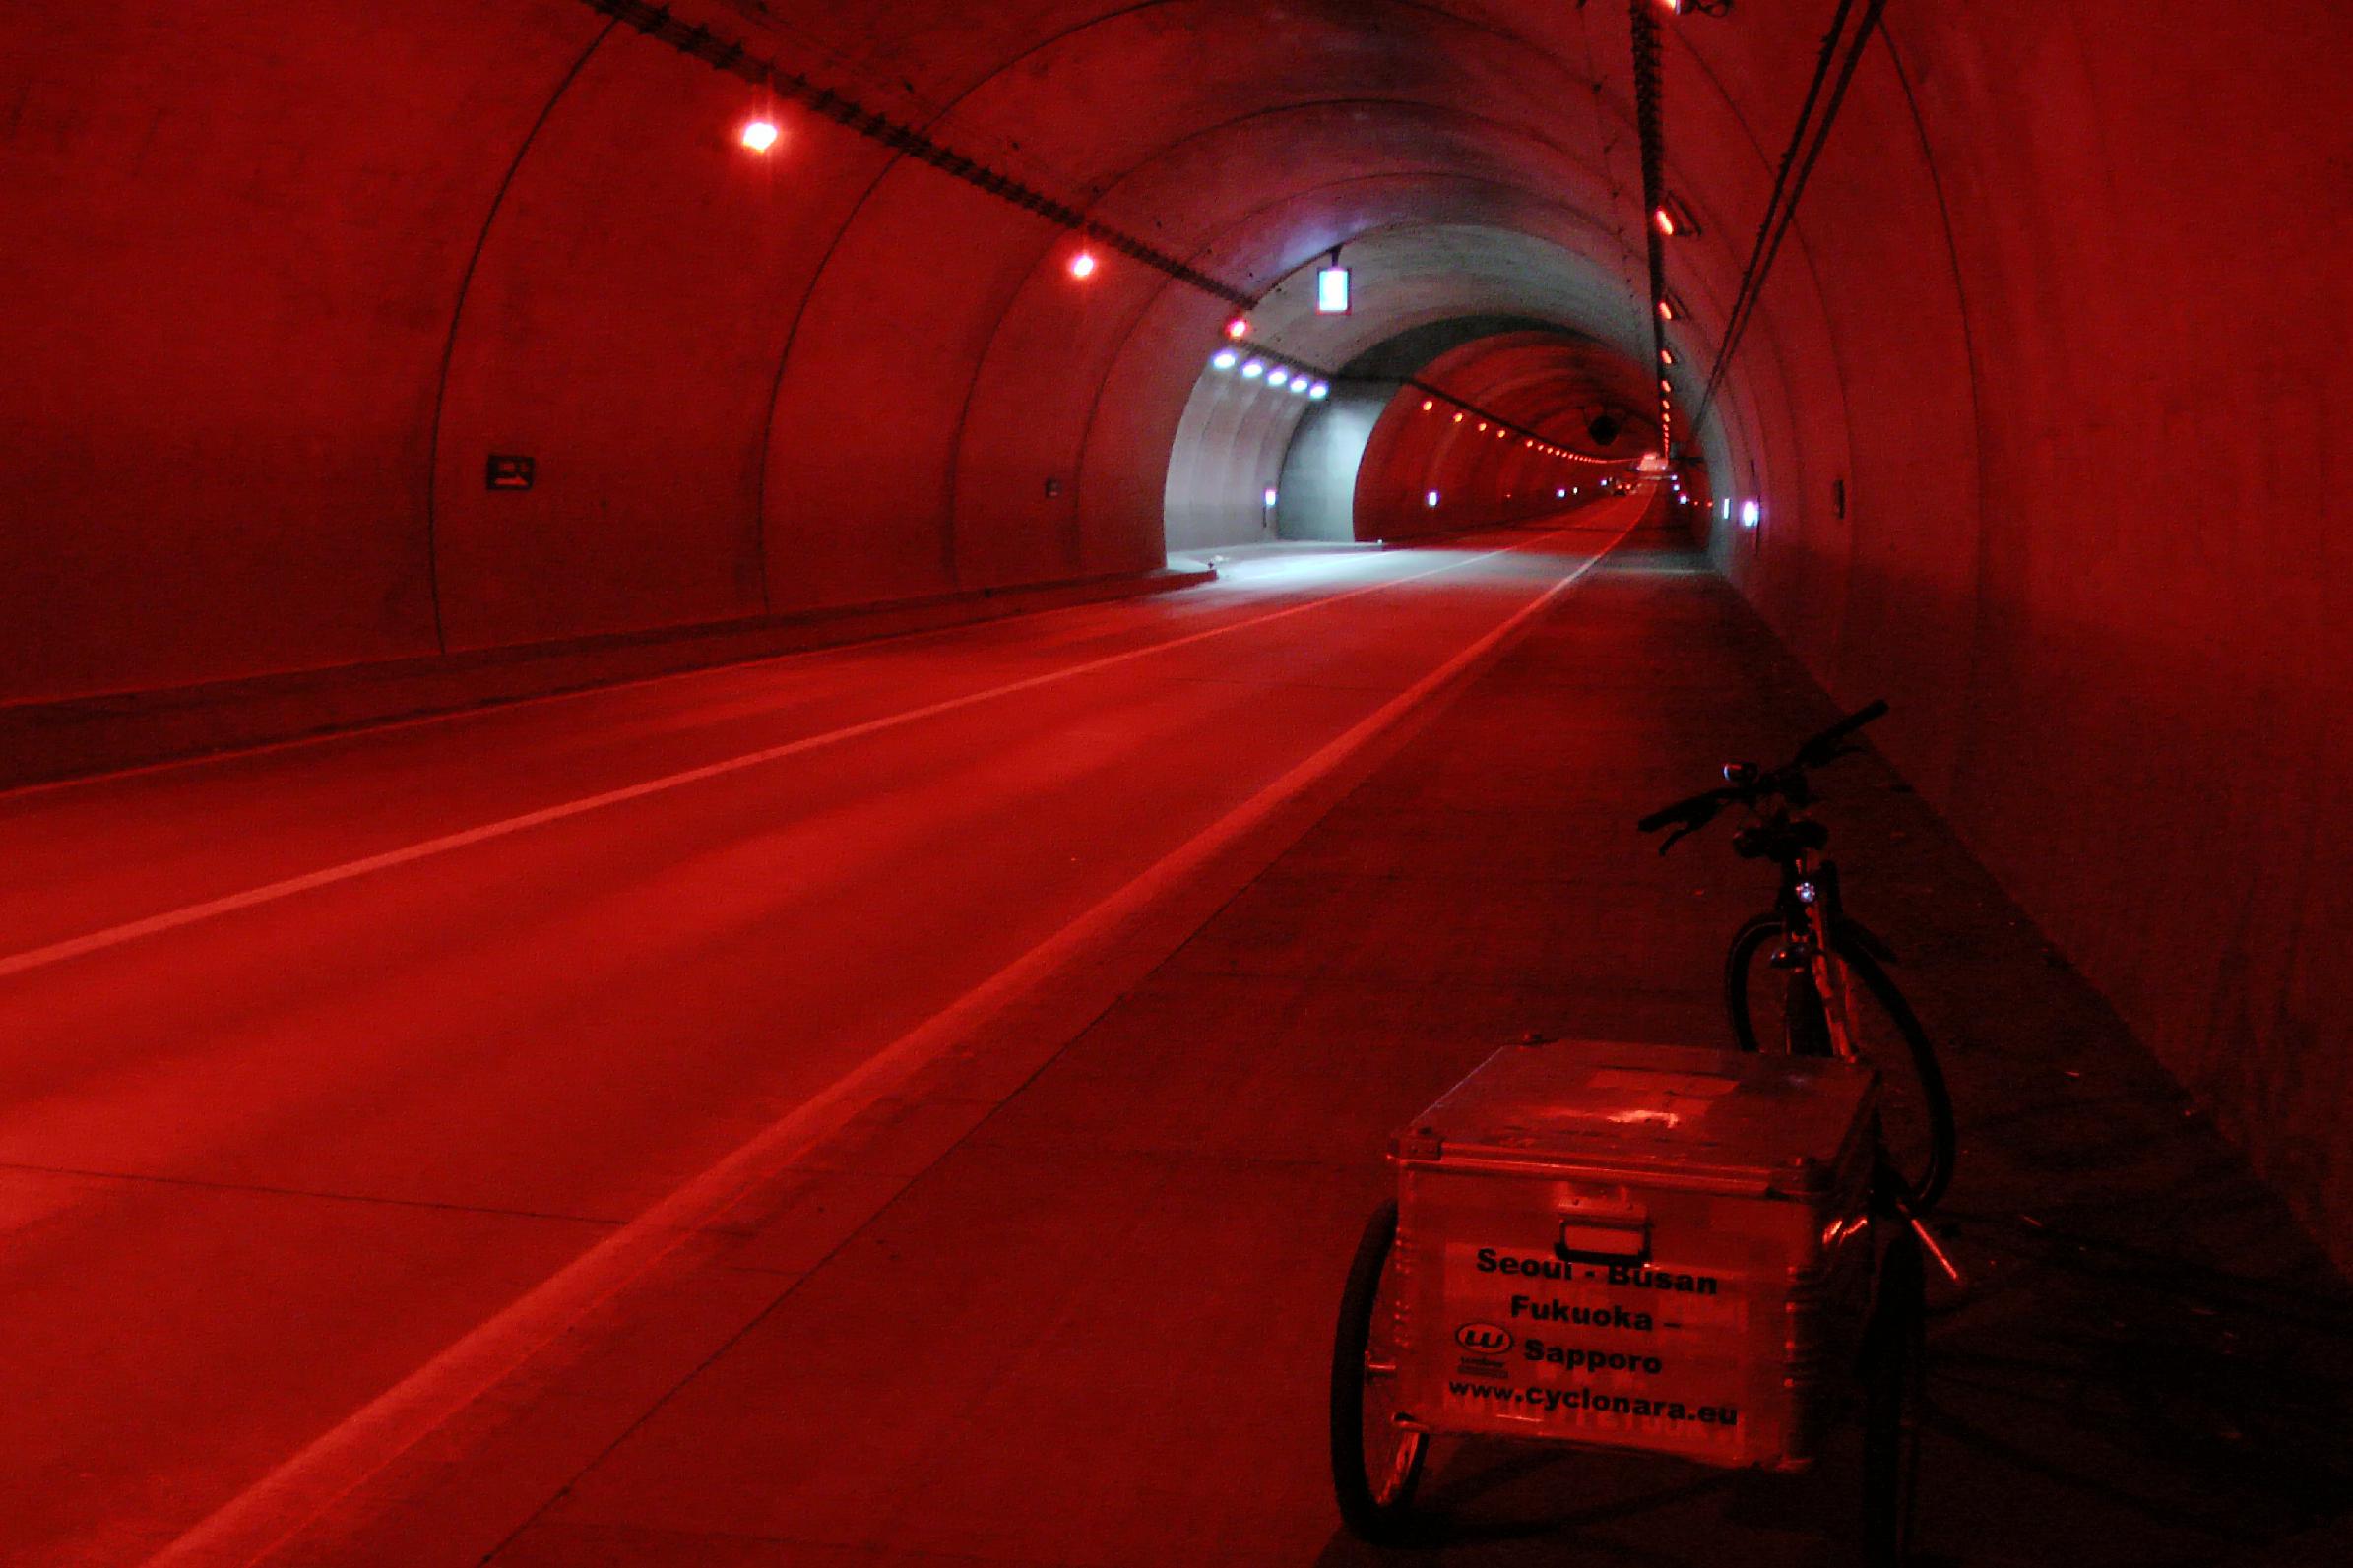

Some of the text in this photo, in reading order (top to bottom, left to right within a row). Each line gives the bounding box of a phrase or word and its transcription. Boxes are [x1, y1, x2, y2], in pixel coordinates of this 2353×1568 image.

[1477, 1248, 1572, 1280] Seoul
[1607, 1261, 1717, 1295] Busan
[1511, 1295, 1653, 1331] Fukuoka
[1525, 1339, 1662, 1374] Sapporo
[1448, 1380, 1738, 1426] www.cyclonara.eu
